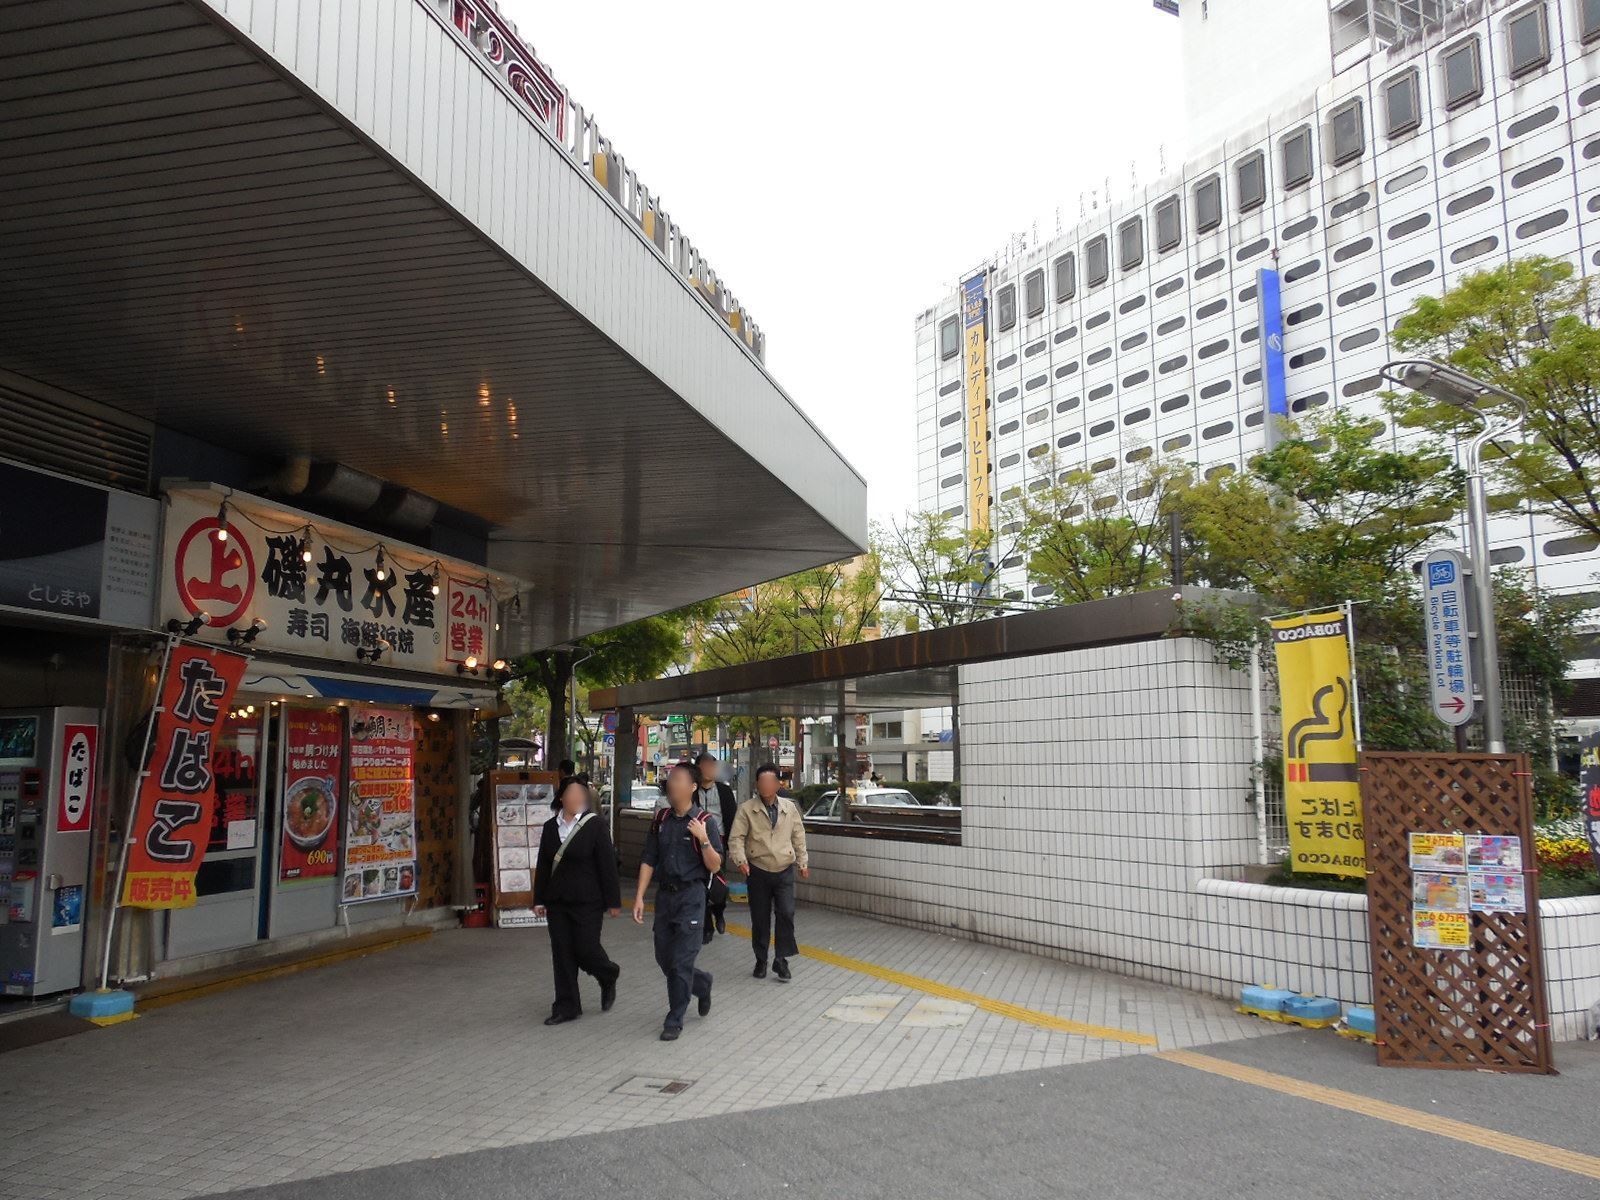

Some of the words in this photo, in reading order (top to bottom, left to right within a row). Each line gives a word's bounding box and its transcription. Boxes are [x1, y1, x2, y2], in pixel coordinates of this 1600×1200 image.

[28, 583, 91, 608] としまや
[262, 535, 435, 628] 磯丸水産
[286, 608, 329, 641] 寿司
[1430, 596, 1439, 630] Bicycle
[450, 622, 483, 656] 営業
[1434, 633, 1443, 671] Parking
[1438, 673, 1446, 688] Lot
[68, 741, 88, 813] たばこ
[145, 658, 226, 864] たばこ
[214, 751, 254, 781] 4h
[292, 758, 328, 770] 始めました
[307, 850, 334, 866] 690円
[130, 876, 192, 903] 販売中
